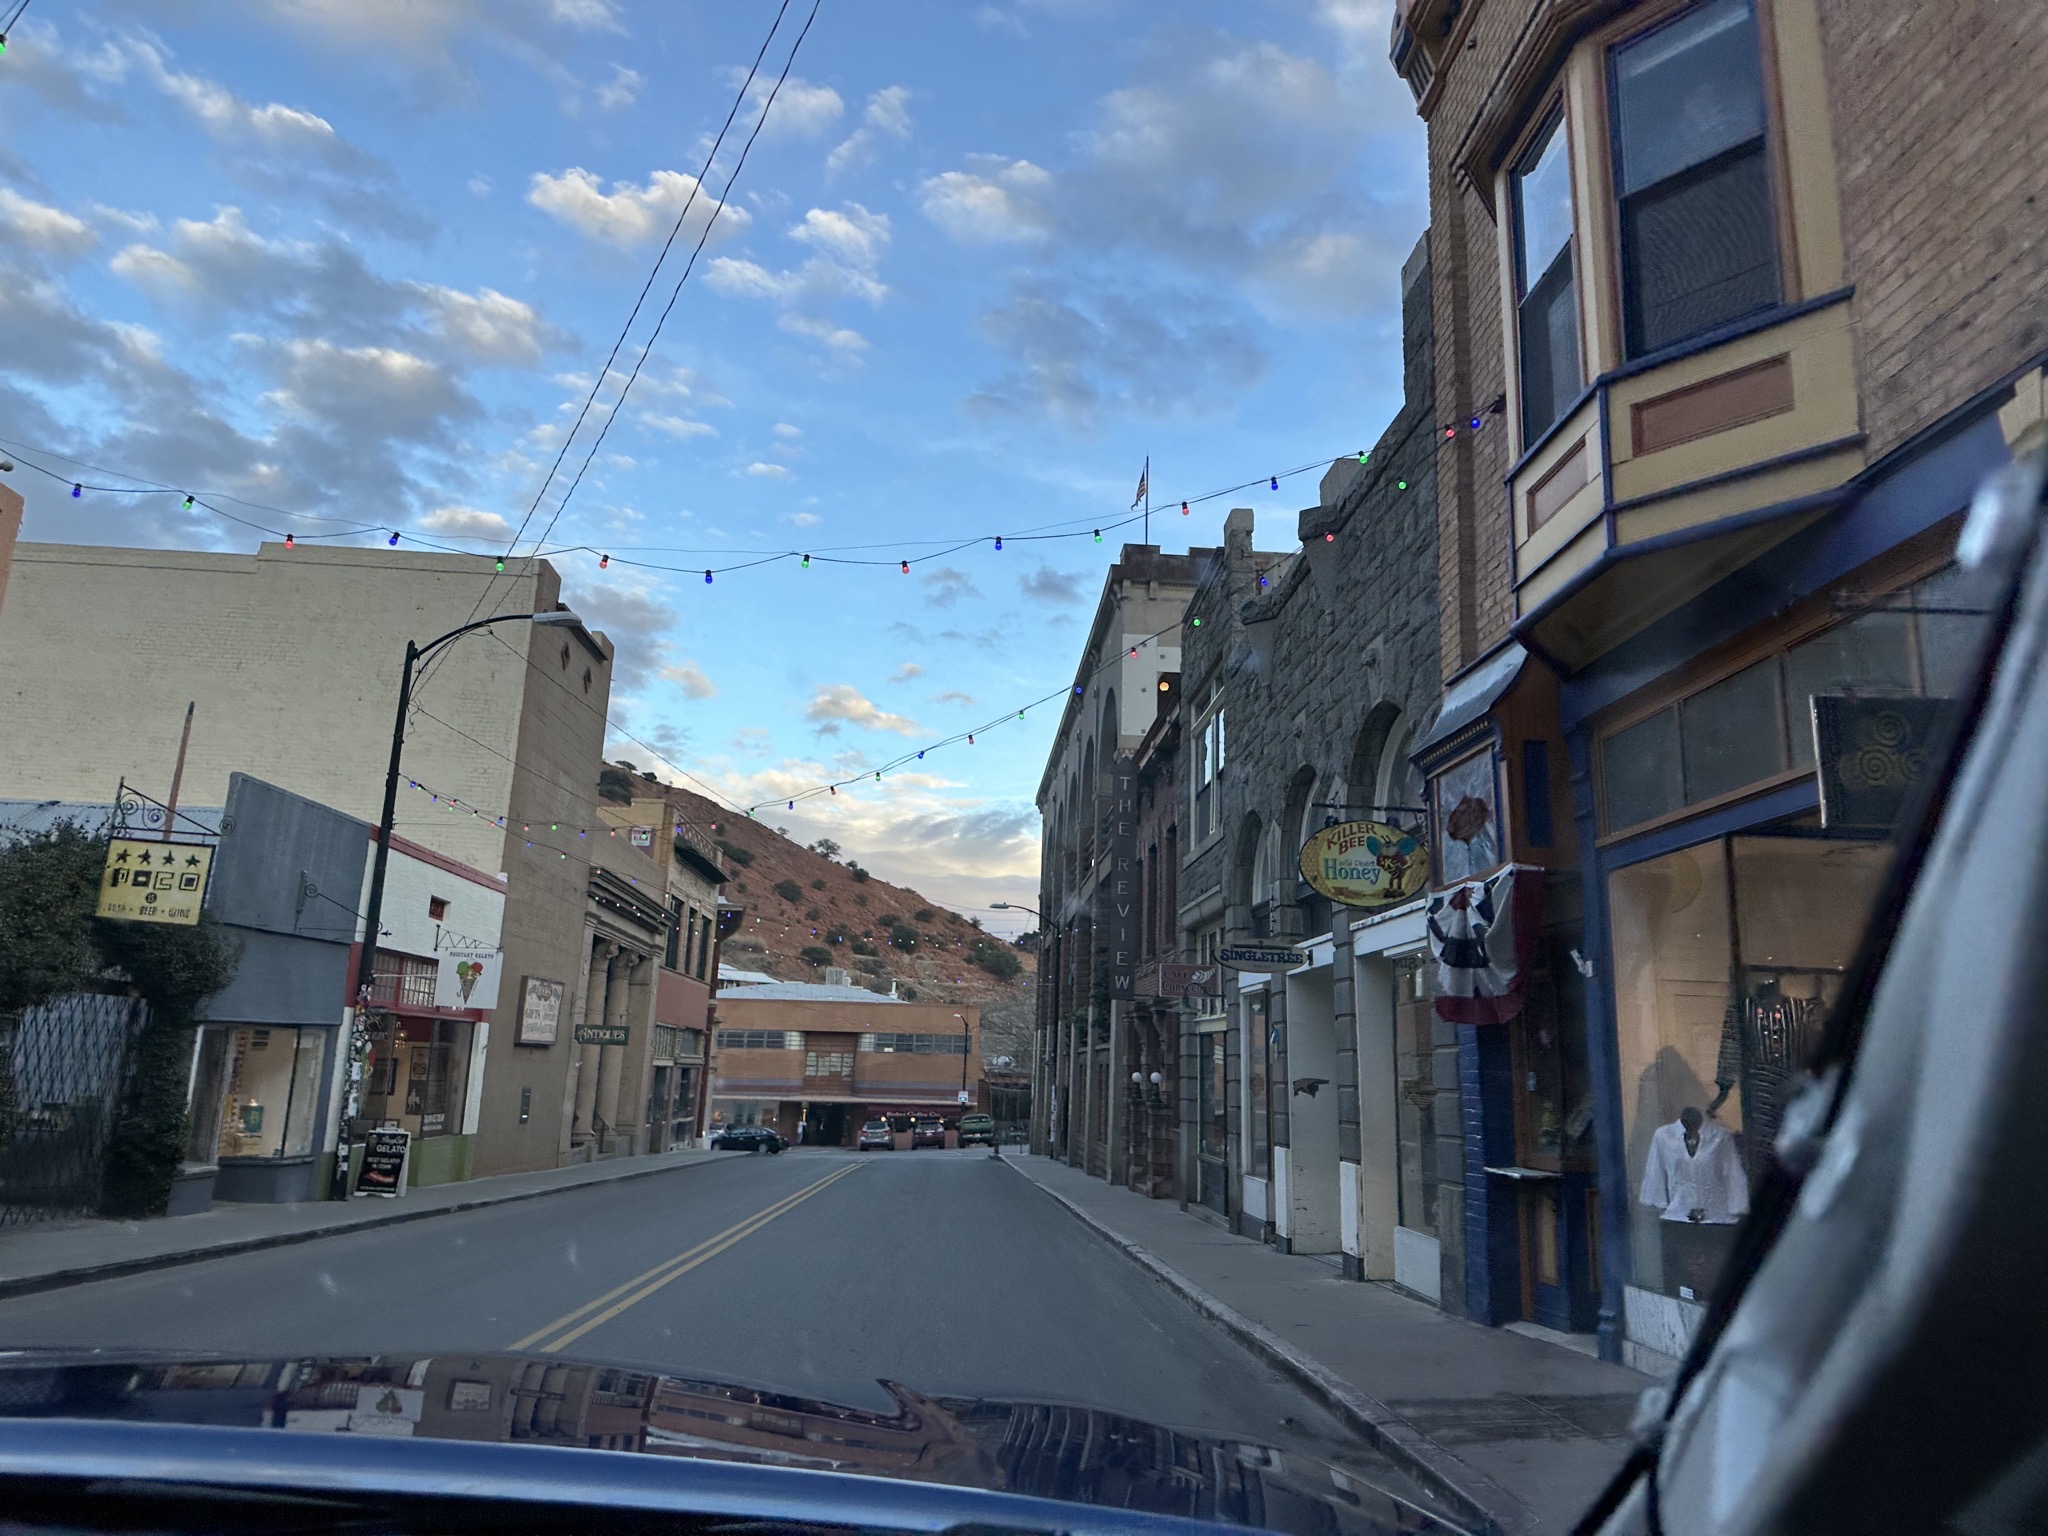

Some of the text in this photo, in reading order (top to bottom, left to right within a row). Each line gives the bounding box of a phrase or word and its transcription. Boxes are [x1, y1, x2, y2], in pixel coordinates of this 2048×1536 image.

[1327, 822, 1377, 850] KILLER
[1339, 836, 1365, 855] BEE
[1324, 858, 1381, 885] Honey
[1115, 776, 1131, 990] THE REVIEW
[1219, 948, 1303, 964] SINGLETREE
[579, 1027, 625, 1041] ANTIQUES
[376, 1144, 406, 1153] GELATO
